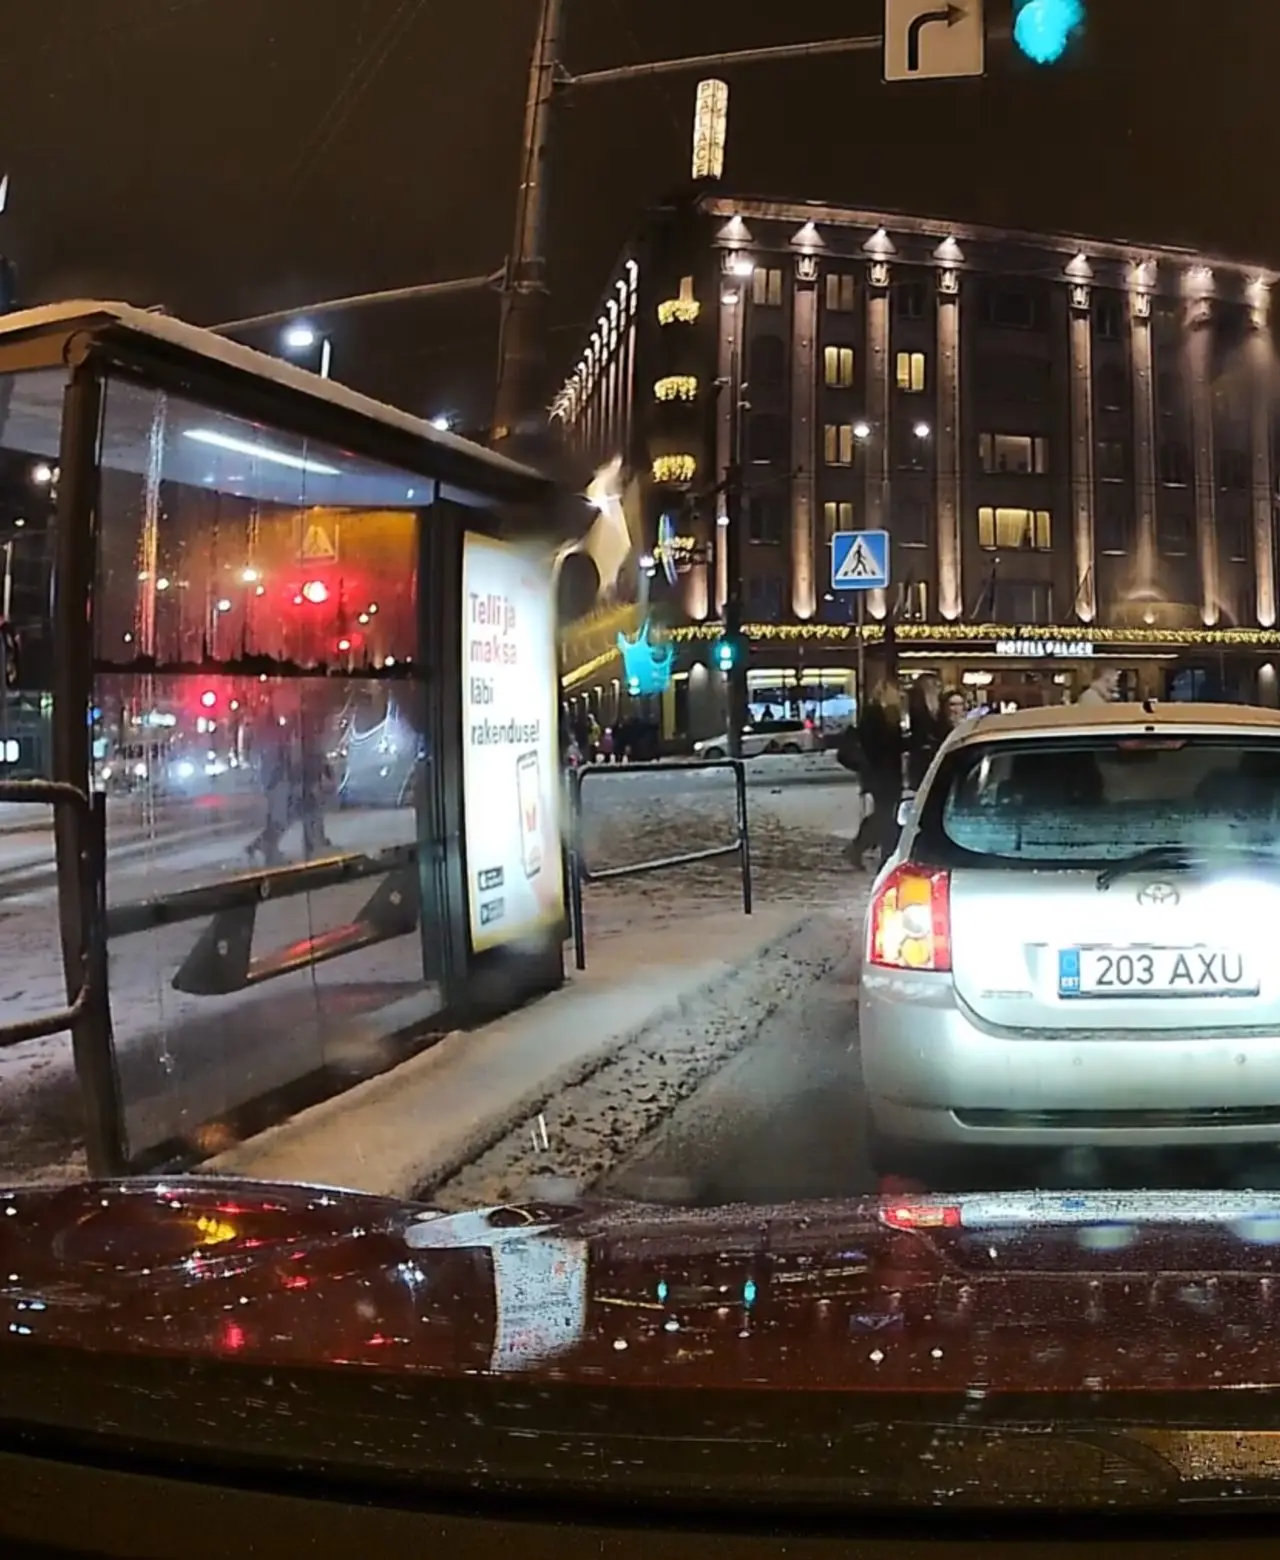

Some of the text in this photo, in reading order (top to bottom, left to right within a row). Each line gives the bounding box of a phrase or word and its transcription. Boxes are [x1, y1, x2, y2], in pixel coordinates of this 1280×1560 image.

[696, 82, 711, 176] PALACE
[470, 592, 516, 636] Telli ja
[470, 635, 517, 665] maksa
[470, 676, 494, 705] läbi
[1096, 954, 1155, 985] 203
[1168, 952, 1243, 985] AXU
